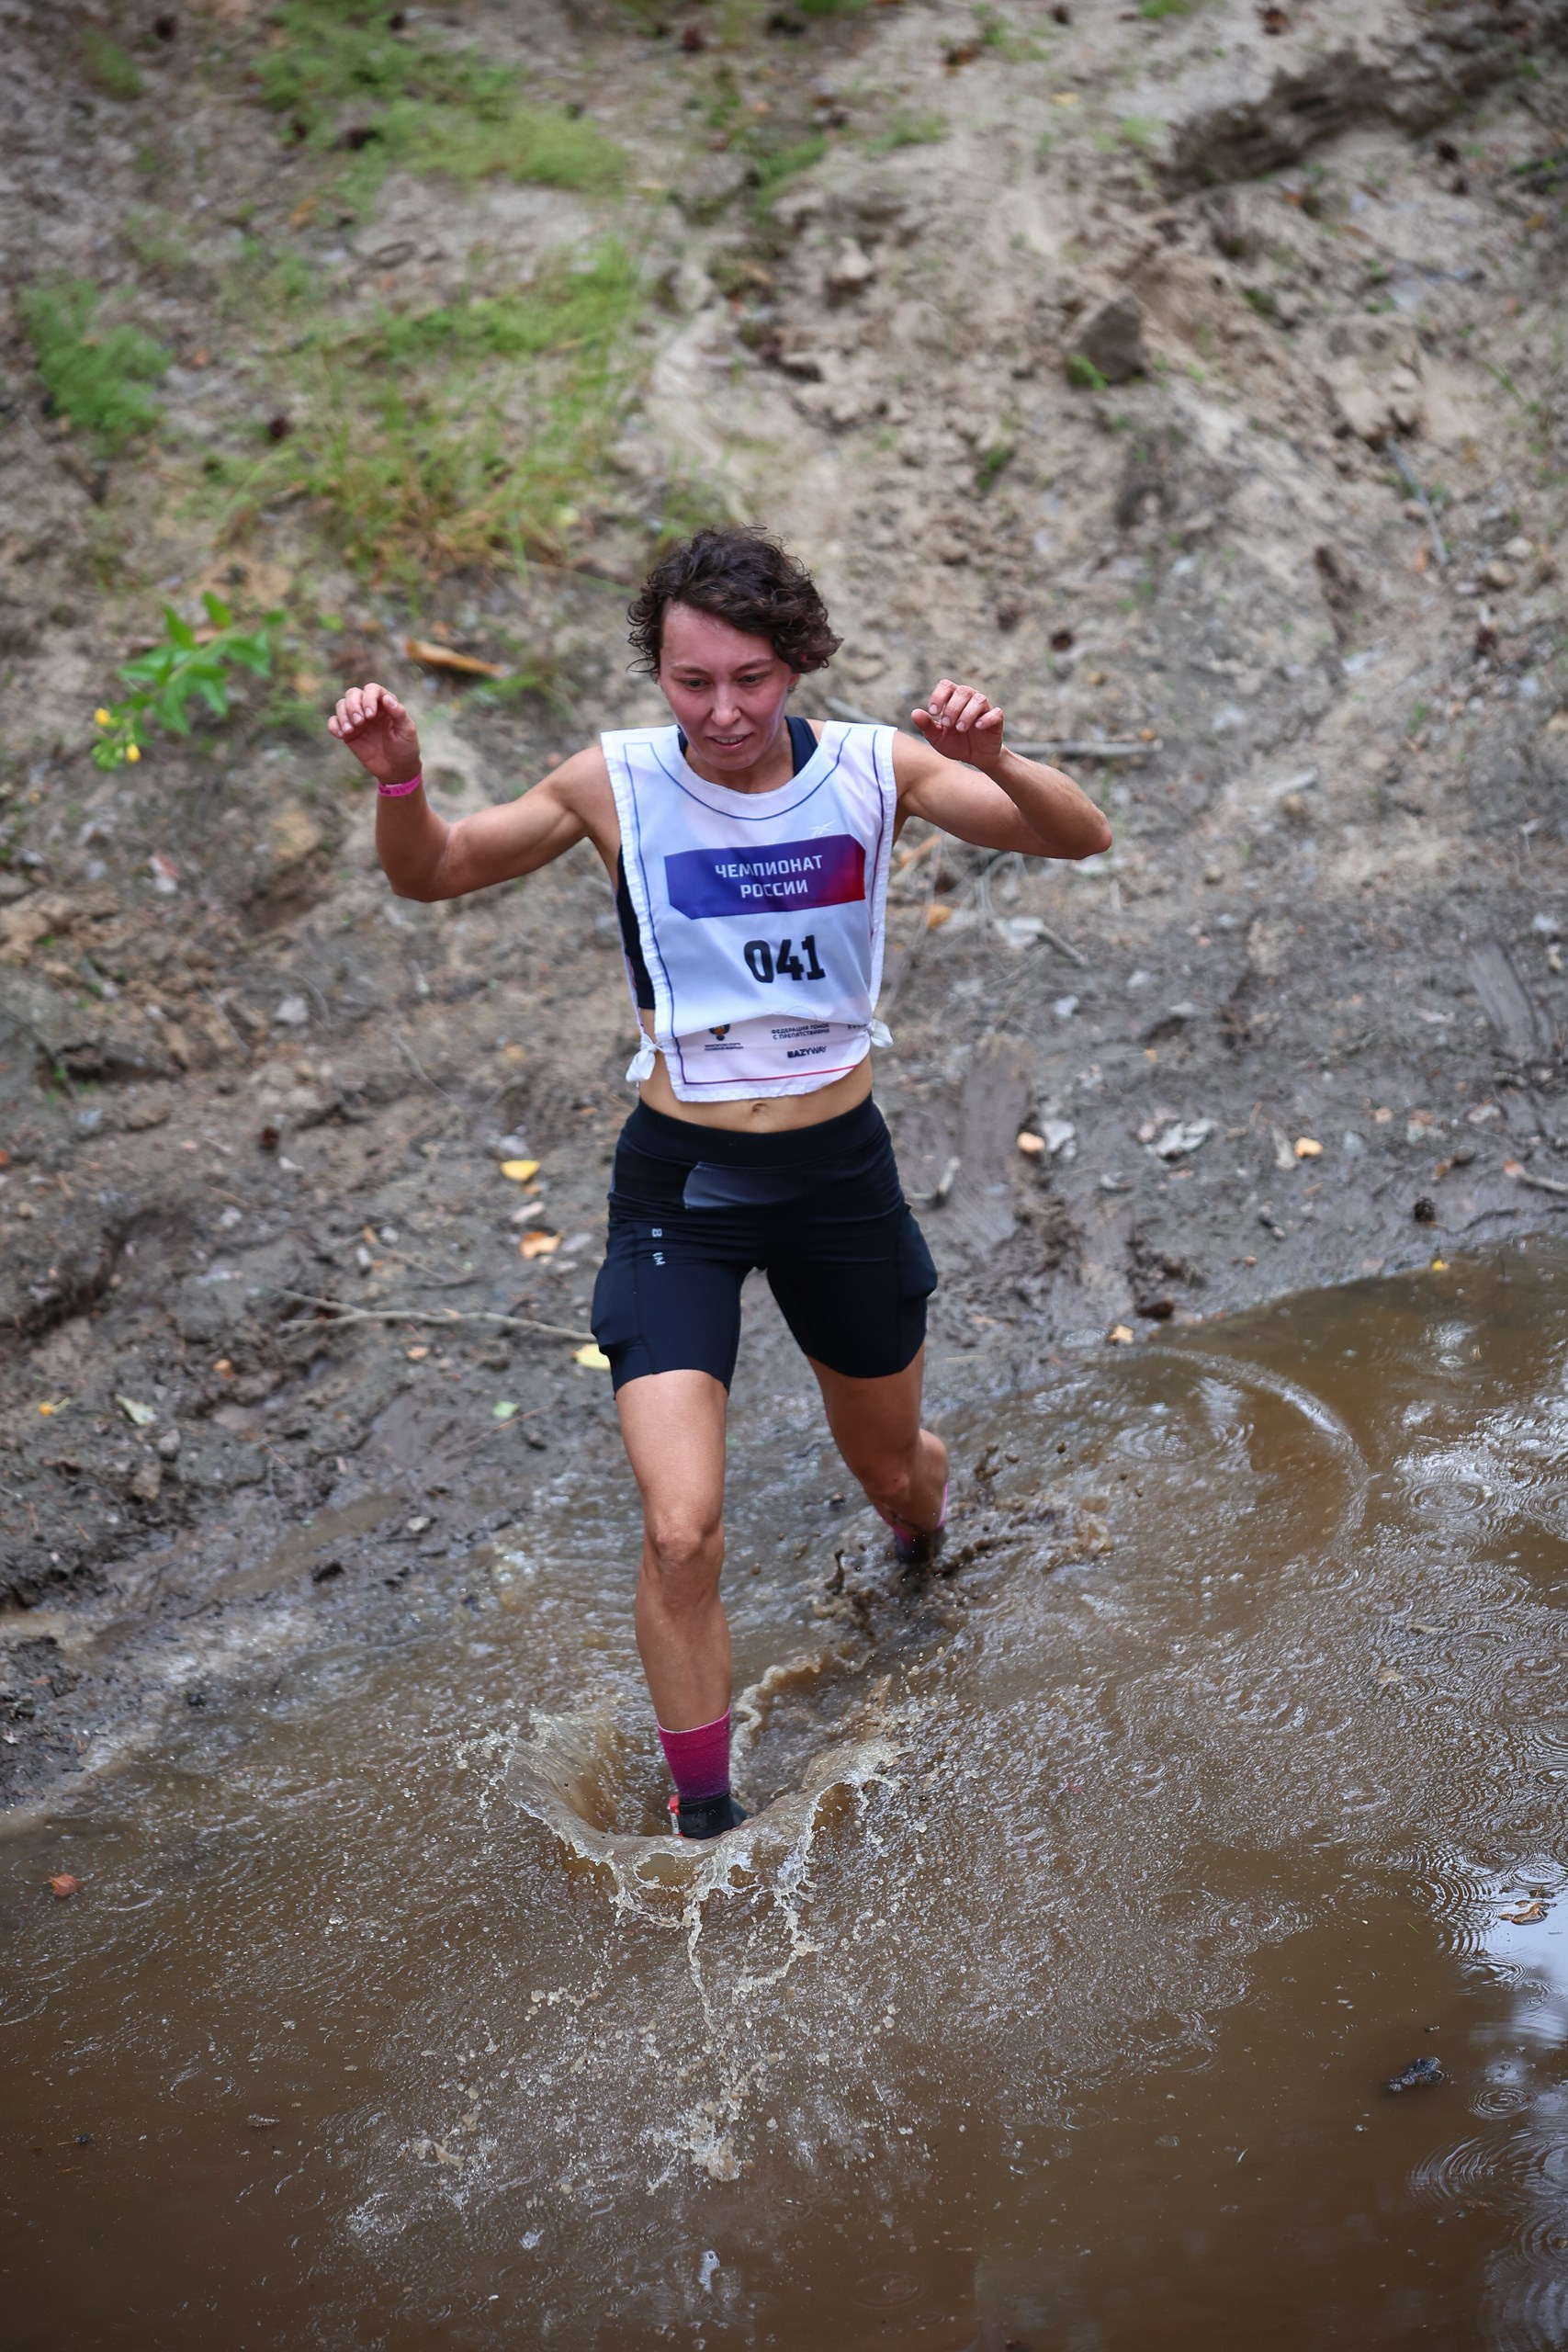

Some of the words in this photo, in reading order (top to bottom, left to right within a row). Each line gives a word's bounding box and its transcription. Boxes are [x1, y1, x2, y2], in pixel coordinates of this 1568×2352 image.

[715, 854, 823, 878] ЧЕМПИОНАТ
[739, 879, 808, 899] РОССИИ
[743, 934, 826, 983] 041
[771, 1024, 809, 1035] ФЕДЕРАЦИЯ
[787, 1046, 827, 1058] EAZYWAY
